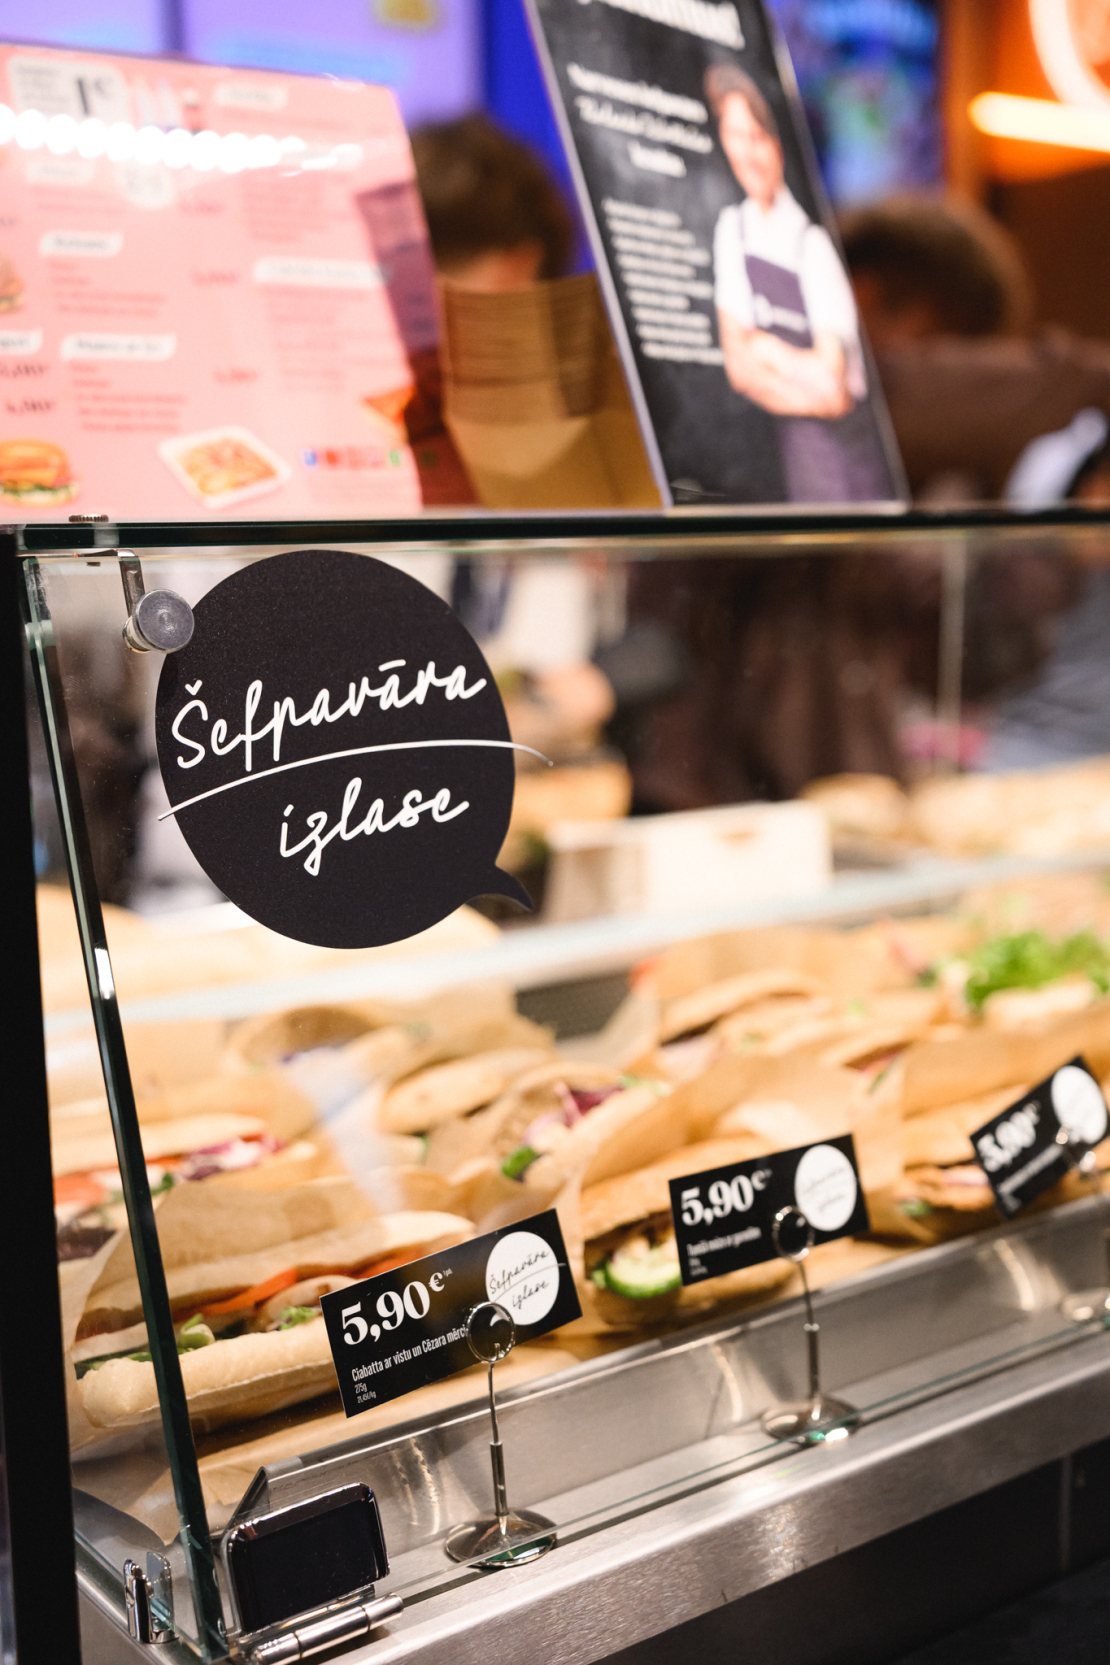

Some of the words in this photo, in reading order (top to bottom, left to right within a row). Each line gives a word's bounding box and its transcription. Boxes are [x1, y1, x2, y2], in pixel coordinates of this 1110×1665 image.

[171, 659, 487, 772] Šefpavāra
[279, 777, 470, 876] izlase
[512, 1281, 550, 1310] izlase
[351, 1360, 384, 1382] Ciabatta
[383, 1356, 393, 1369] ar
[392, 1348, 413, 1365] vistu
[412, 1344, 423, 1357] un
[421, 1335, 447, 1353] Cēzara
